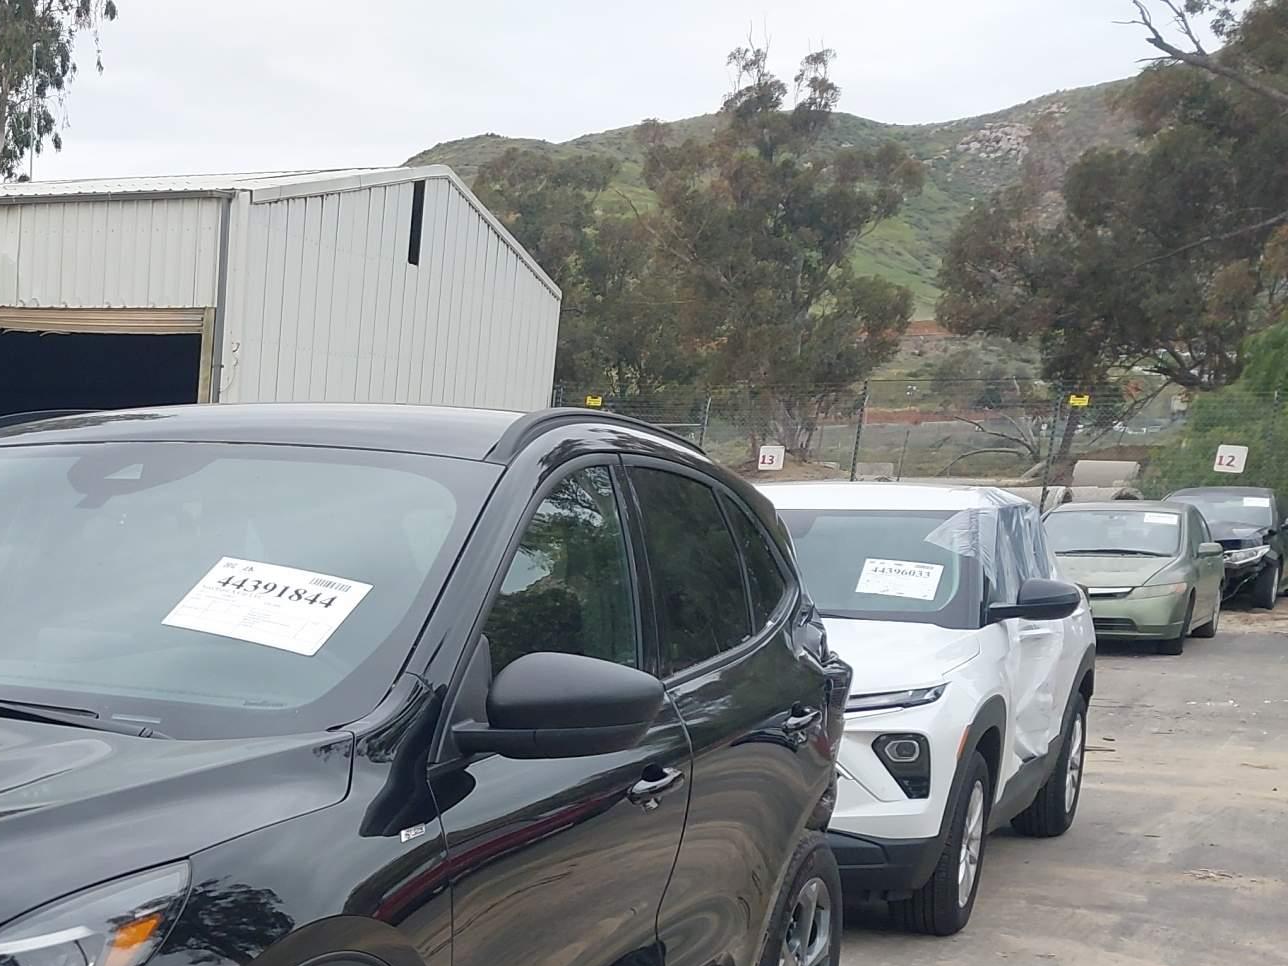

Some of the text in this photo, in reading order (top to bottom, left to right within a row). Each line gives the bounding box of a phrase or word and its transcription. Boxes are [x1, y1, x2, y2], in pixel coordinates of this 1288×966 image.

[760, 454, 775, 465] 13
[1217, 455, 1236, 467] 12
[217, 575, 337, 608] 44391844
